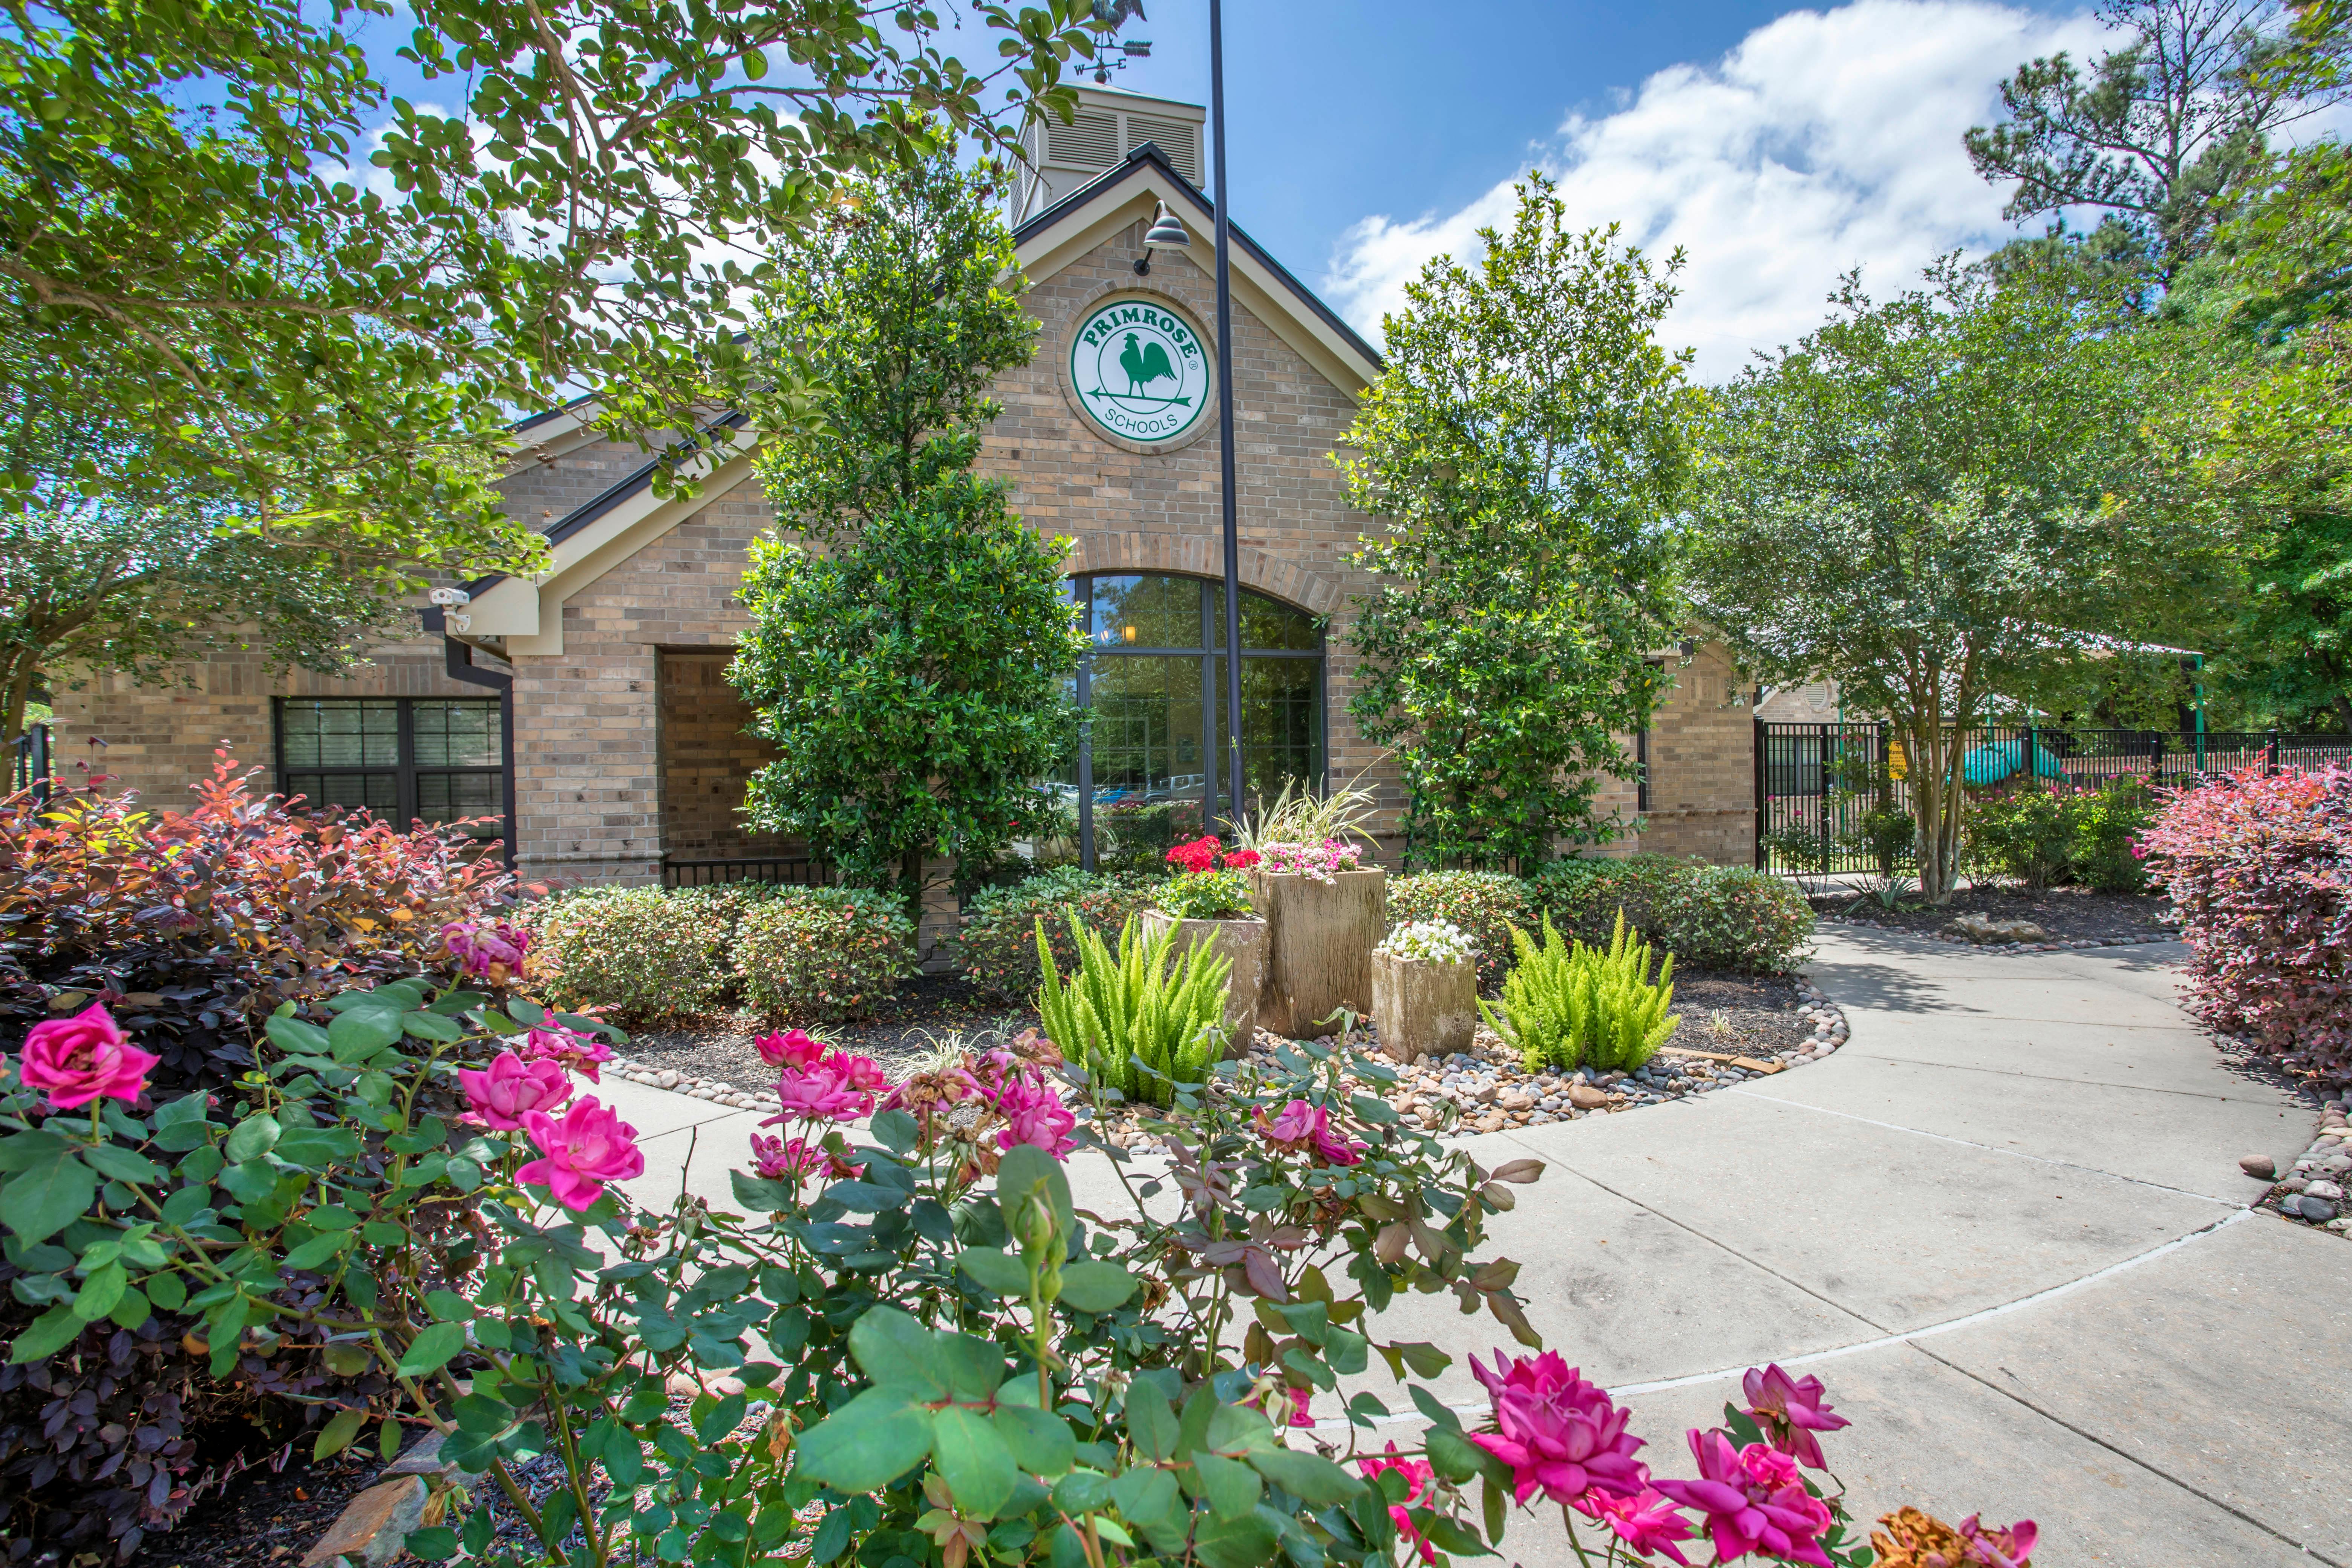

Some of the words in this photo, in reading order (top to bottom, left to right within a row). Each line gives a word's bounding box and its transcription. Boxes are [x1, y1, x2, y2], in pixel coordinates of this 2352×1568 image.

[1117, 58, 1126, 69] E
[1074, 64, 1085, 76] W
[1105, 408, 1178, 433] SCHOOLS
